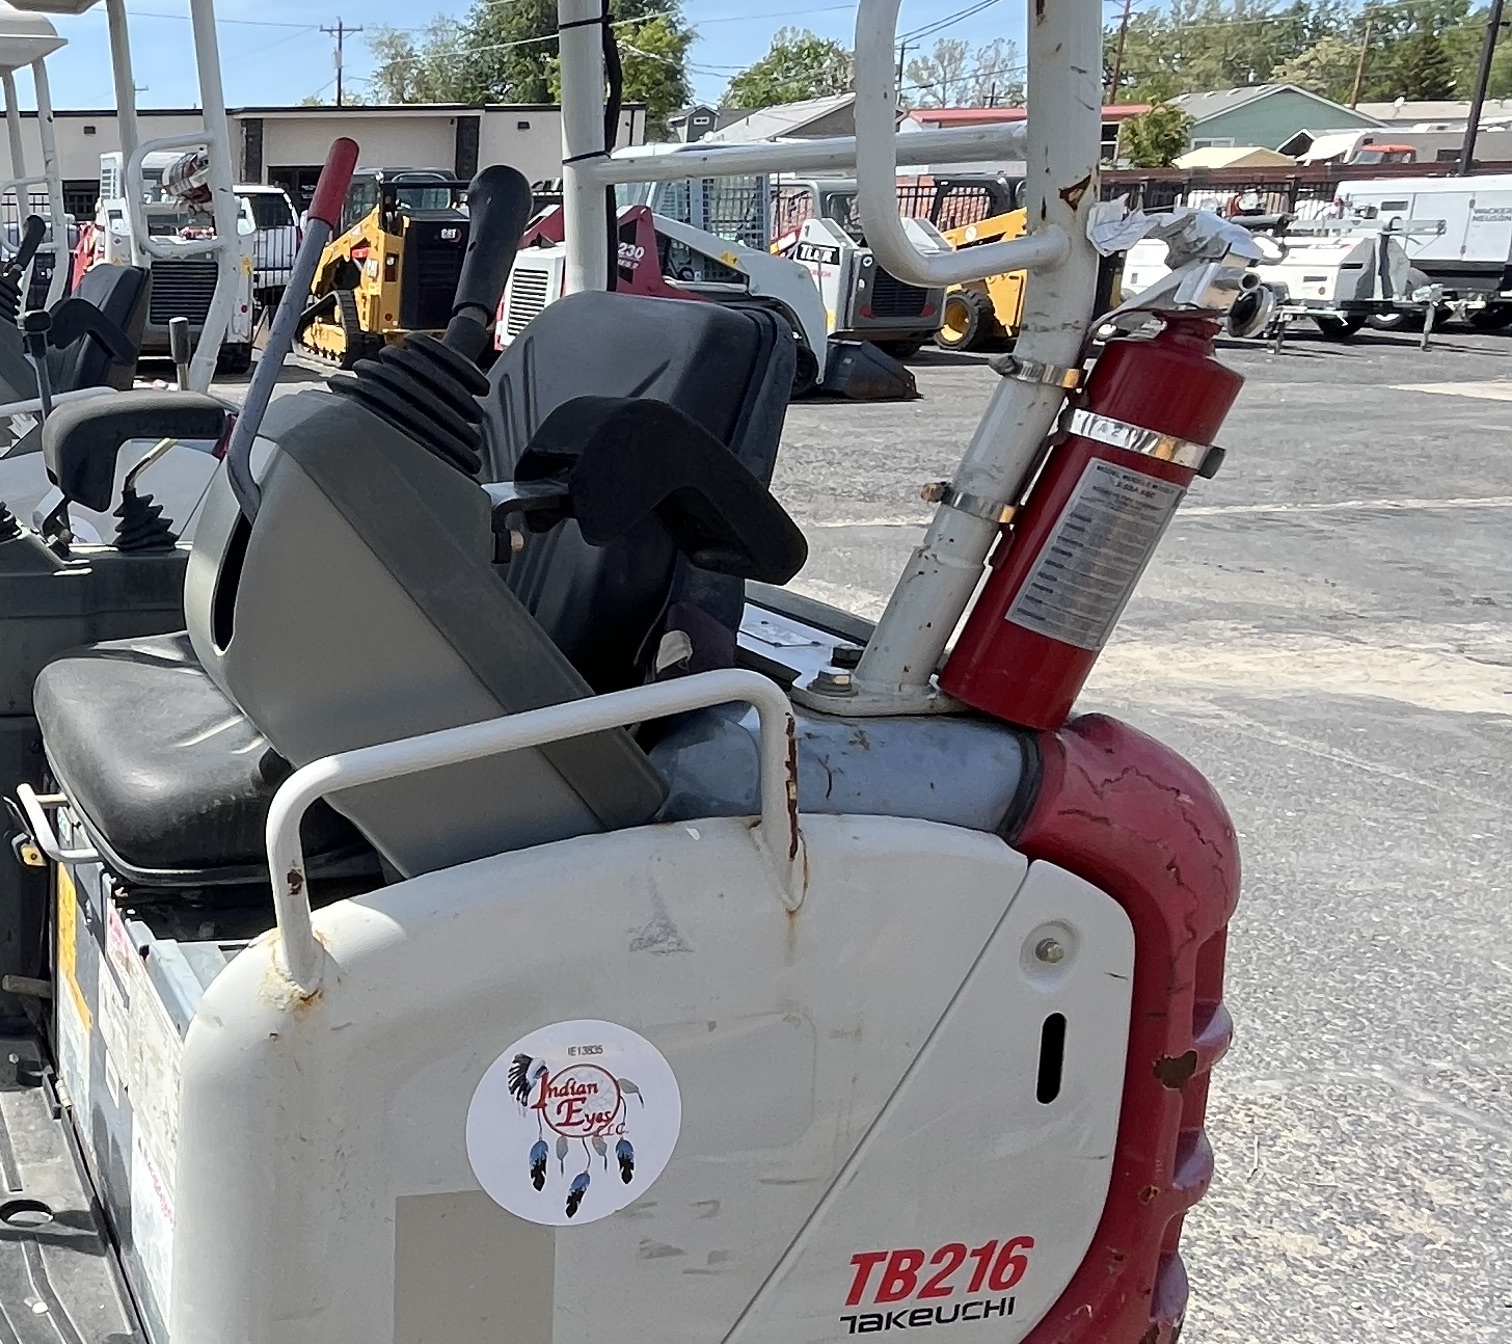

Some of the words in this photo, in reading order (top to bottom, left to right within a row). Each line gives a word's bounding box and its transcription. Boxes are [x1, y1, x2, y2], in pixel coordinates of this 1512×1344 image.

[441, 228, 457, 239] CAT
[530, 1071, 598, 1109] Indian
[555, 1098, 611, 1131] Eyes
[845, 1236, 1034, 1305] TB216
[840, 1296, 1016, 1334] TAKEUCHI
